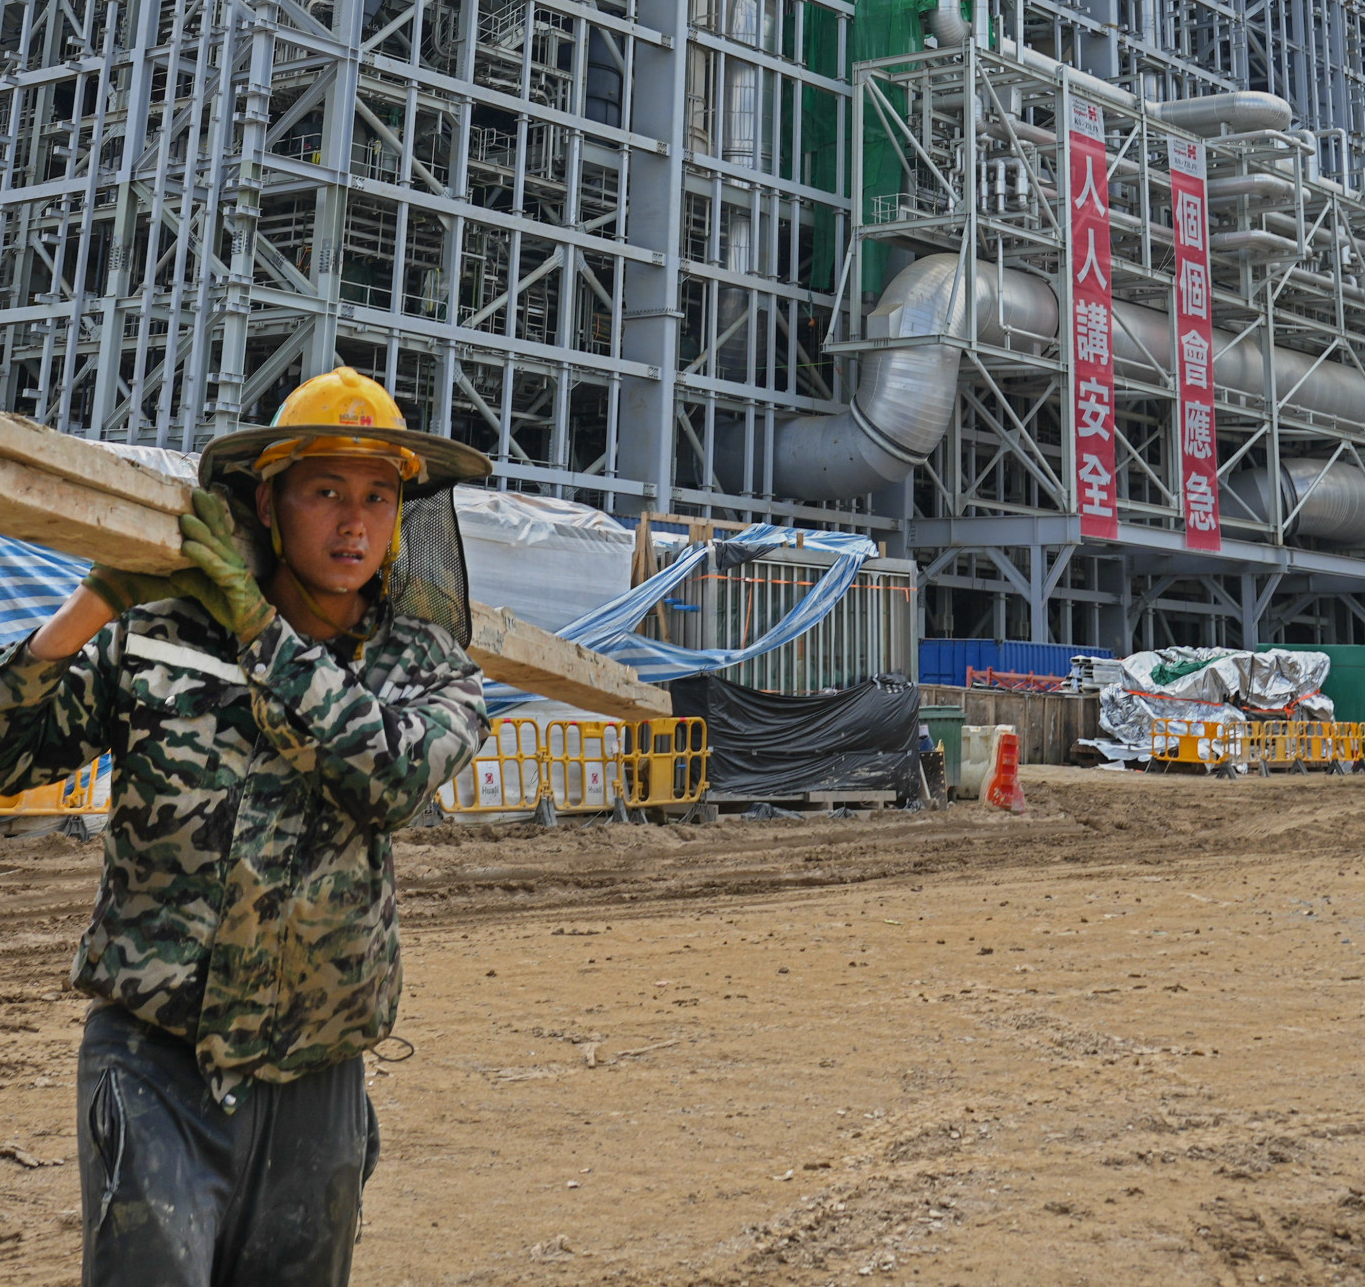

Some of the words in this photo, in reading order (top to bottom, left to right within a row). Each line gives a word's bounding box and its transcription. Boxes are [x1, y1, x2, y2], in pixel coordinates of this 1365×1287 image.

[1075, 156, 1113, 517] 人人講安全
[1176, 189, 1217, 531] 個個會應急
